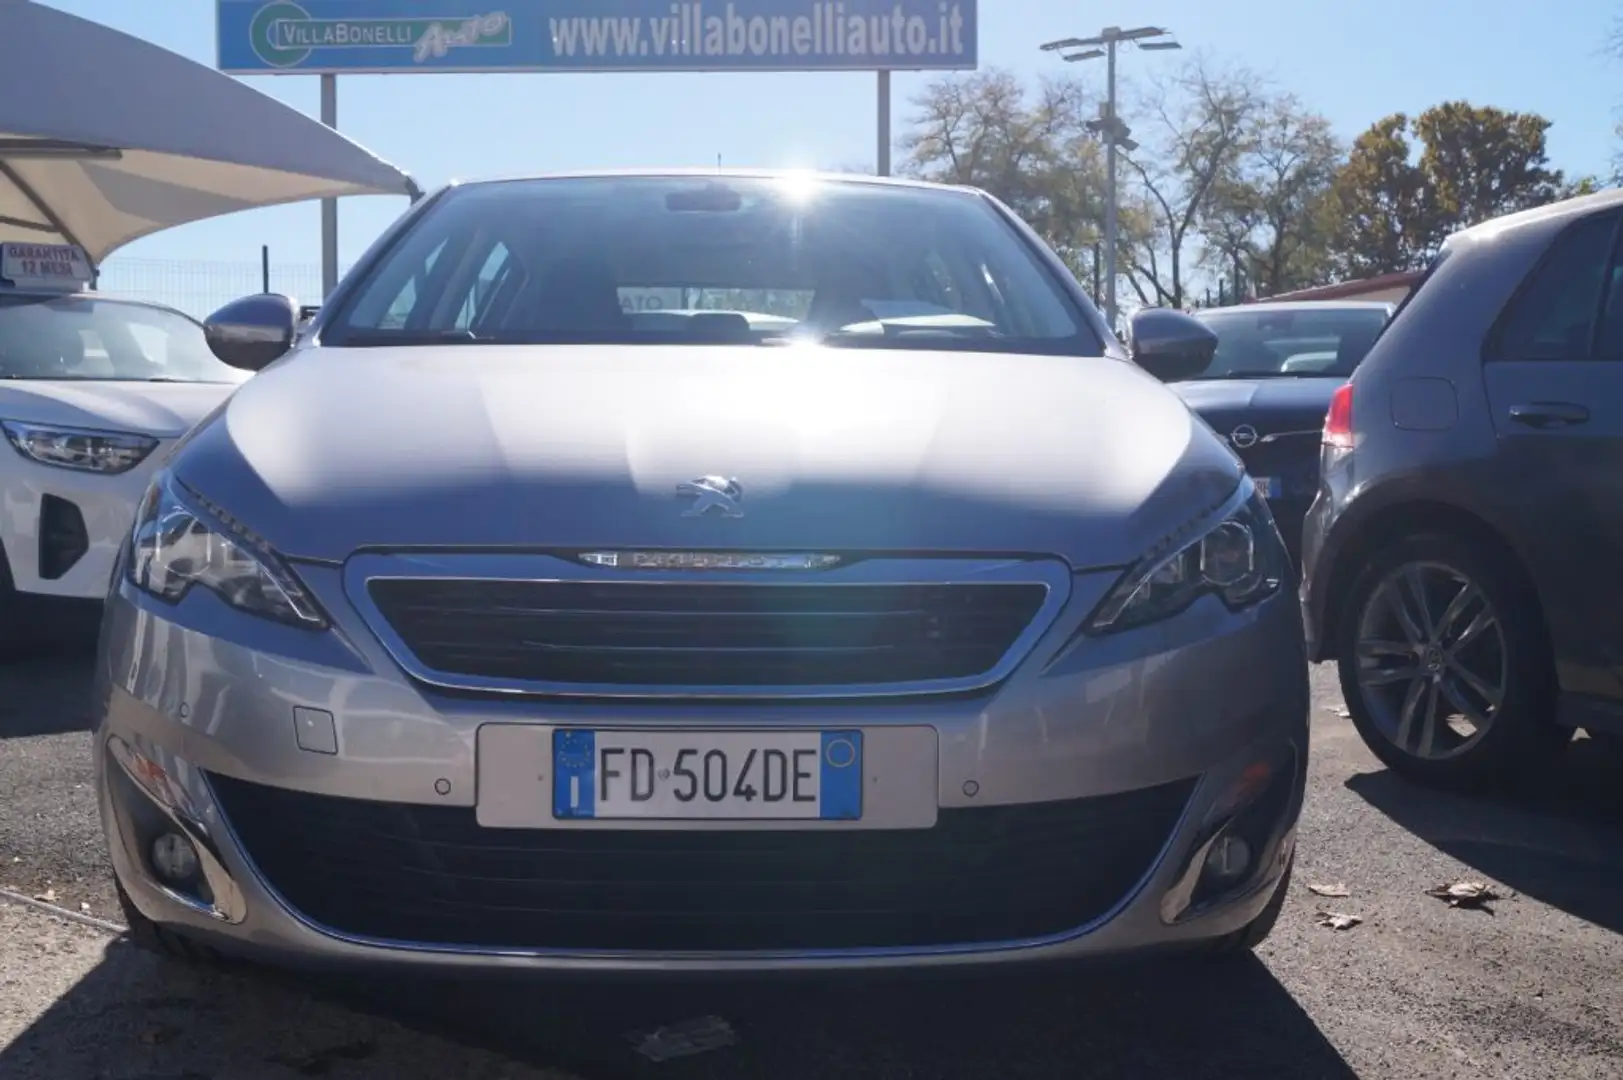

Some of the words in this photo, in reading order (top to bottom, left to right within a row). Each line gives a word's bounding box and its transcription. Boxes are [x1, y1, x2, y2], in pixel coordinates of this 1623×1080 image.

[549, 2, 964, 57] www.villabonelliauto.it
[21, 260, 36, 275] 12
[601, 747, 655, 802] FD
[673, 747, 818, 802] 504DE
